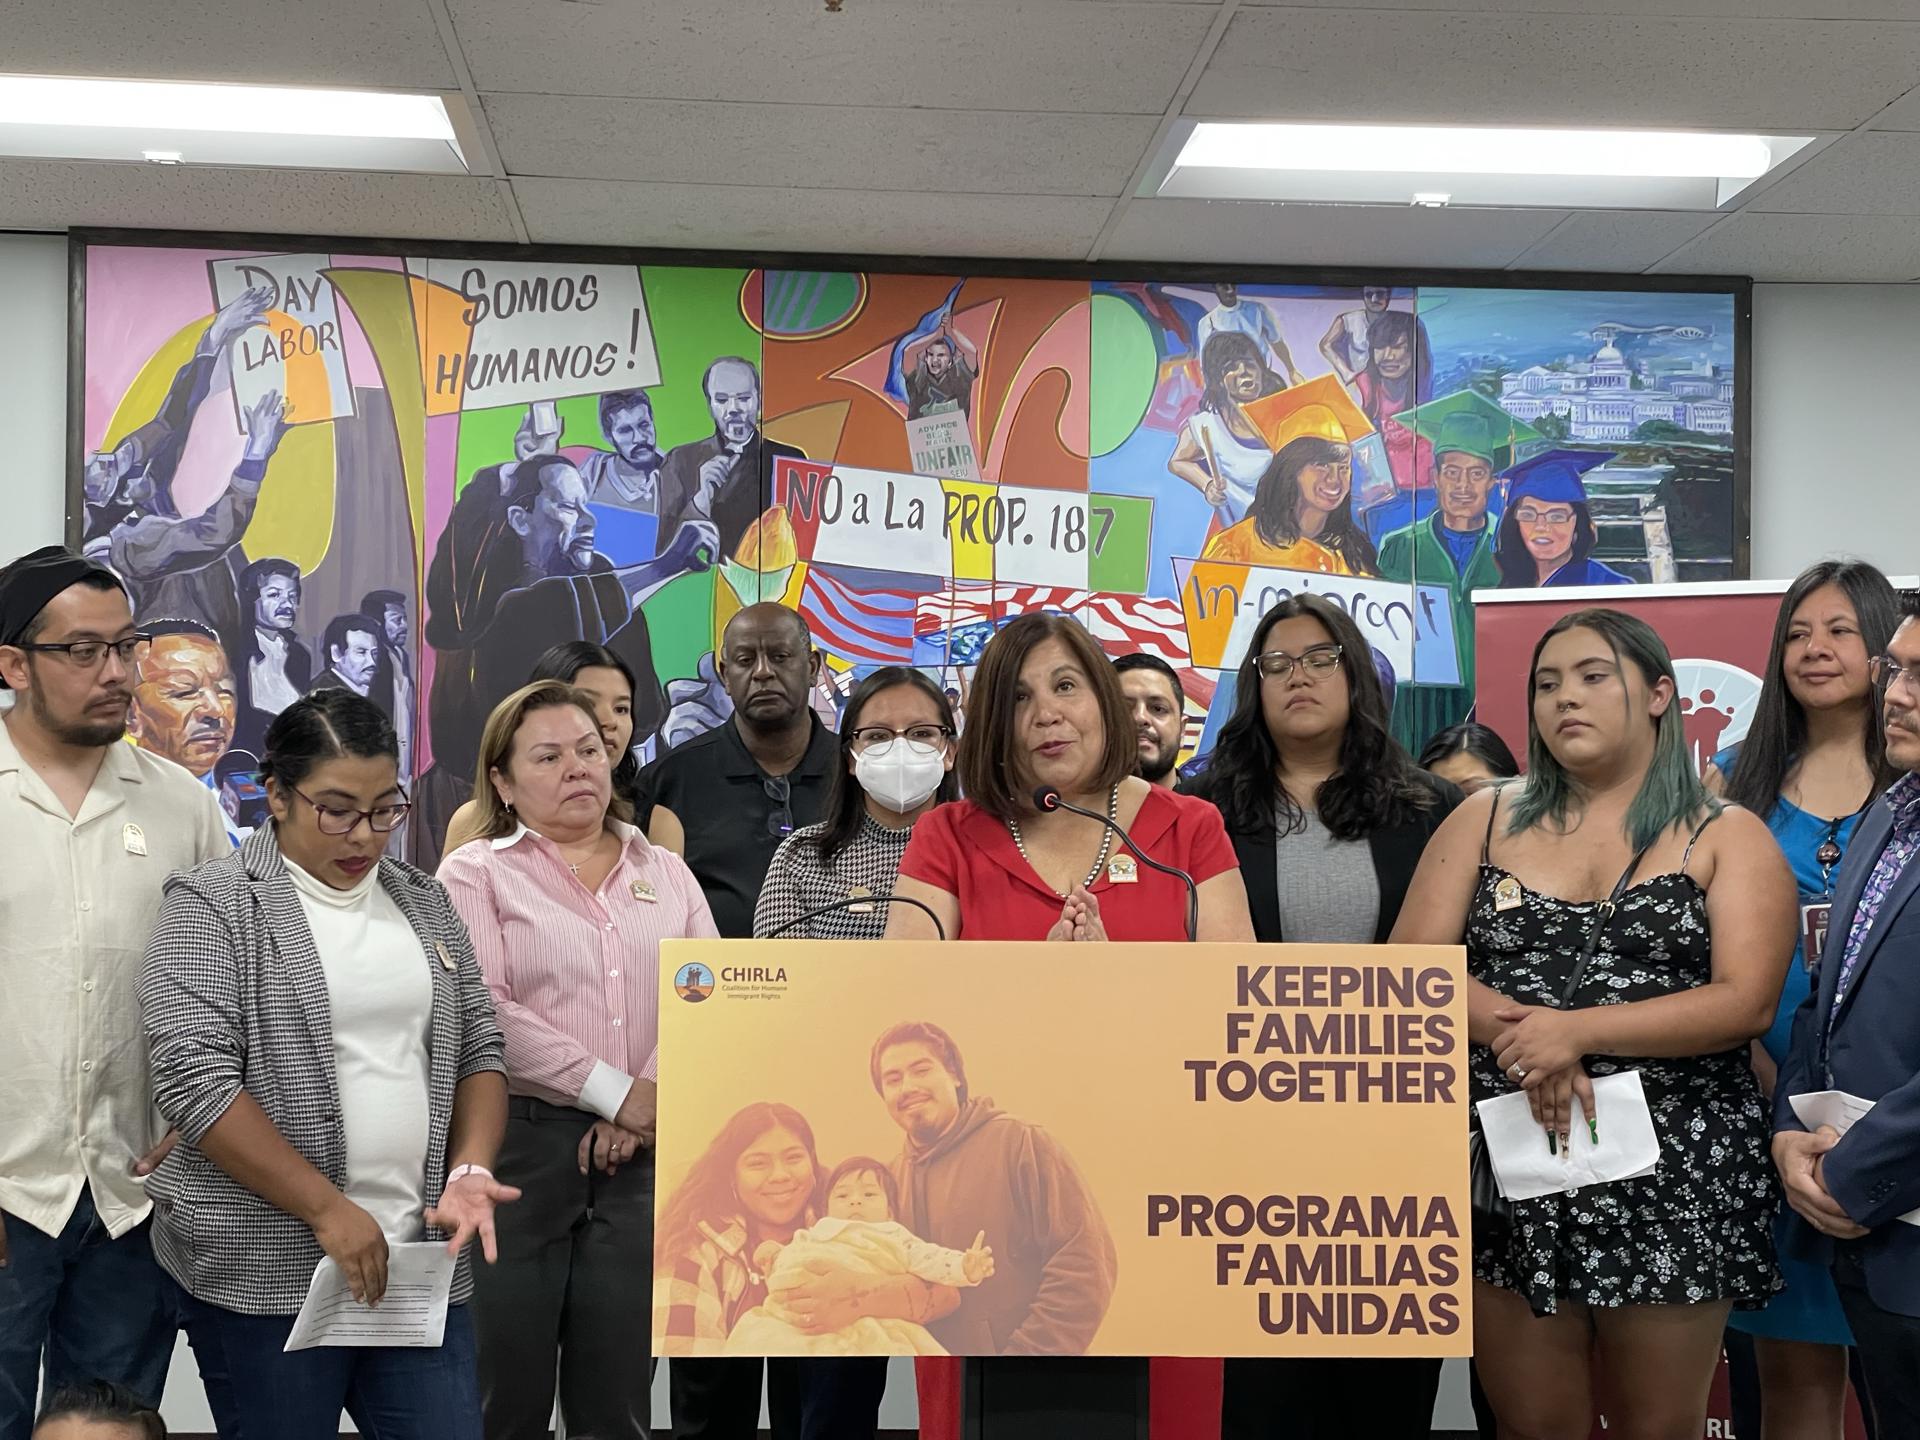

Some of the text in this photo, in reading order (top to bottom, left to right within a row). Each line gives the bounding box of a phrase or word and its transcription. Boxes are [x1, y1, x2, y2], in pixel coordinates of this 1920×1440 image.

[235, 265, 322, 313] DAY
[461, 268, 598, 326] SOMOS
[243, 321, 338, 371] LABOR
[436, 308, 640, 394] HUMANOS!
[918, 420, 957, 433] ADVANCE
[916, 445, 973, 472] UNFAIR
[787, 468, 1115, 558] NO a La PROP. 187
[721, 967, 787, 982] CHIRLA
[1236, 966, 1455, 1008] KEEPING
[1226, 1013, 1456, 1056] FAMILIES
[1184, 1060, 1456, 1103] TOGETHER
[1147, 1195, 1460, 1238] PROGRAMA
[1216, 1243, 1460, 1287] FAMILIAS
[1258, 1292, 1460, 1336] UNIDAS
